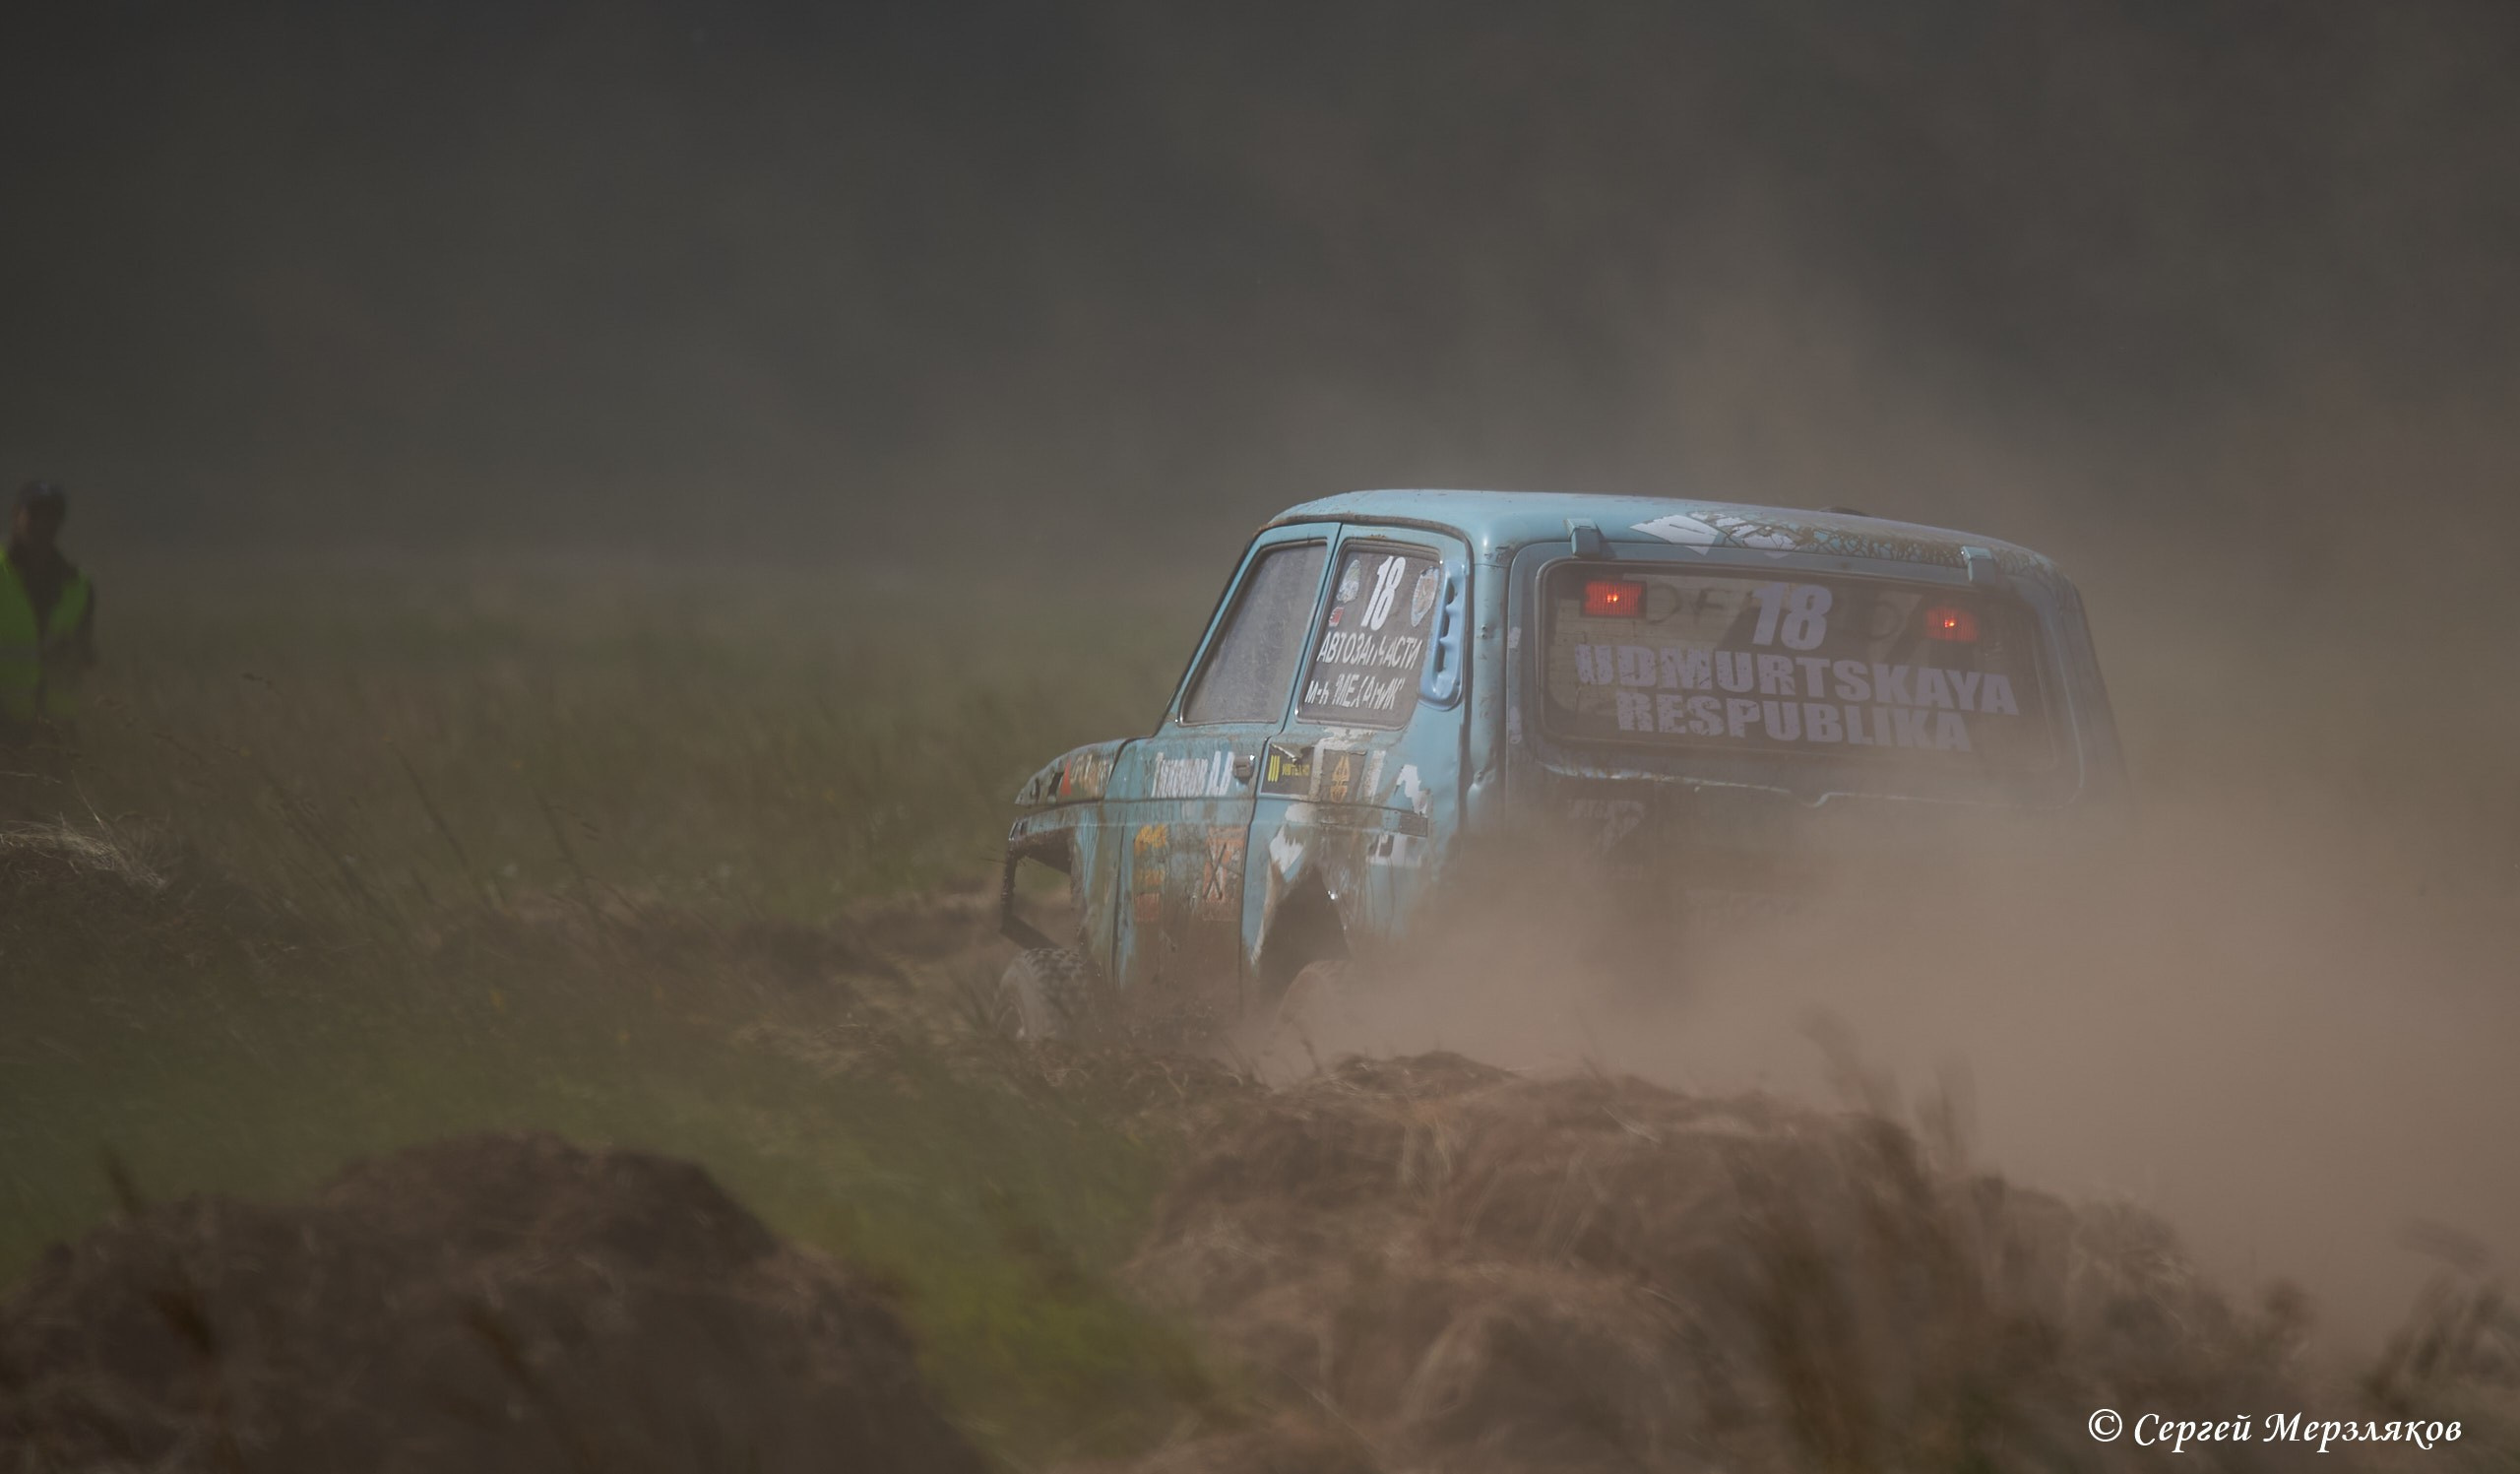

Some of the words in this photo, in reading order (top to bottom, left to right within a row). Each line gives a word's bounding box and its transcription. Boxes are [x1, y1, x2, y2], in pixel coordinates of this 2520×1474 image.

[1361, 555, 1407, 630] 18
[1752, 582, 1832, 651] 18
[1575, 643, 2020, 716] UDMURTSKAYA
[1616, 691, 1973, 752] RESPUBLIKA
